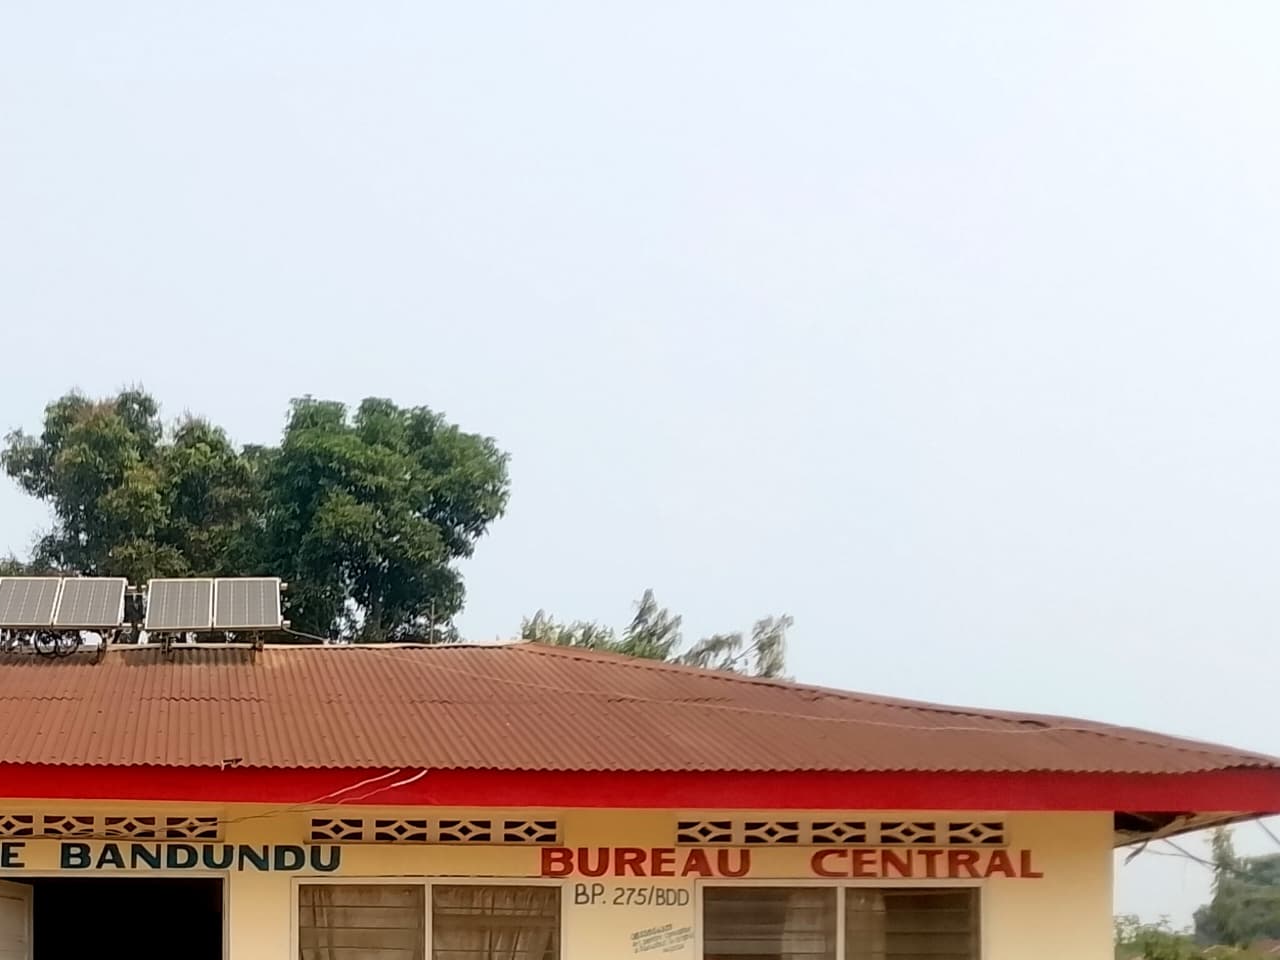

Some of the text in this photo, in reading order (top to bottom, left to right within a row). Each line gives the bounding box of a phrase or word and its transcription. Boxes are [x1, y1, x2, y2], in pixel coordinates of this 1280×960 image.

[61, 842, 342, 872] BANDUNDU
[540, 847, 751, 877] BUREAU
[810, 848, 1044, 879] CENTRAL
[574, 883, 690, 906] BP. 275/BDD
